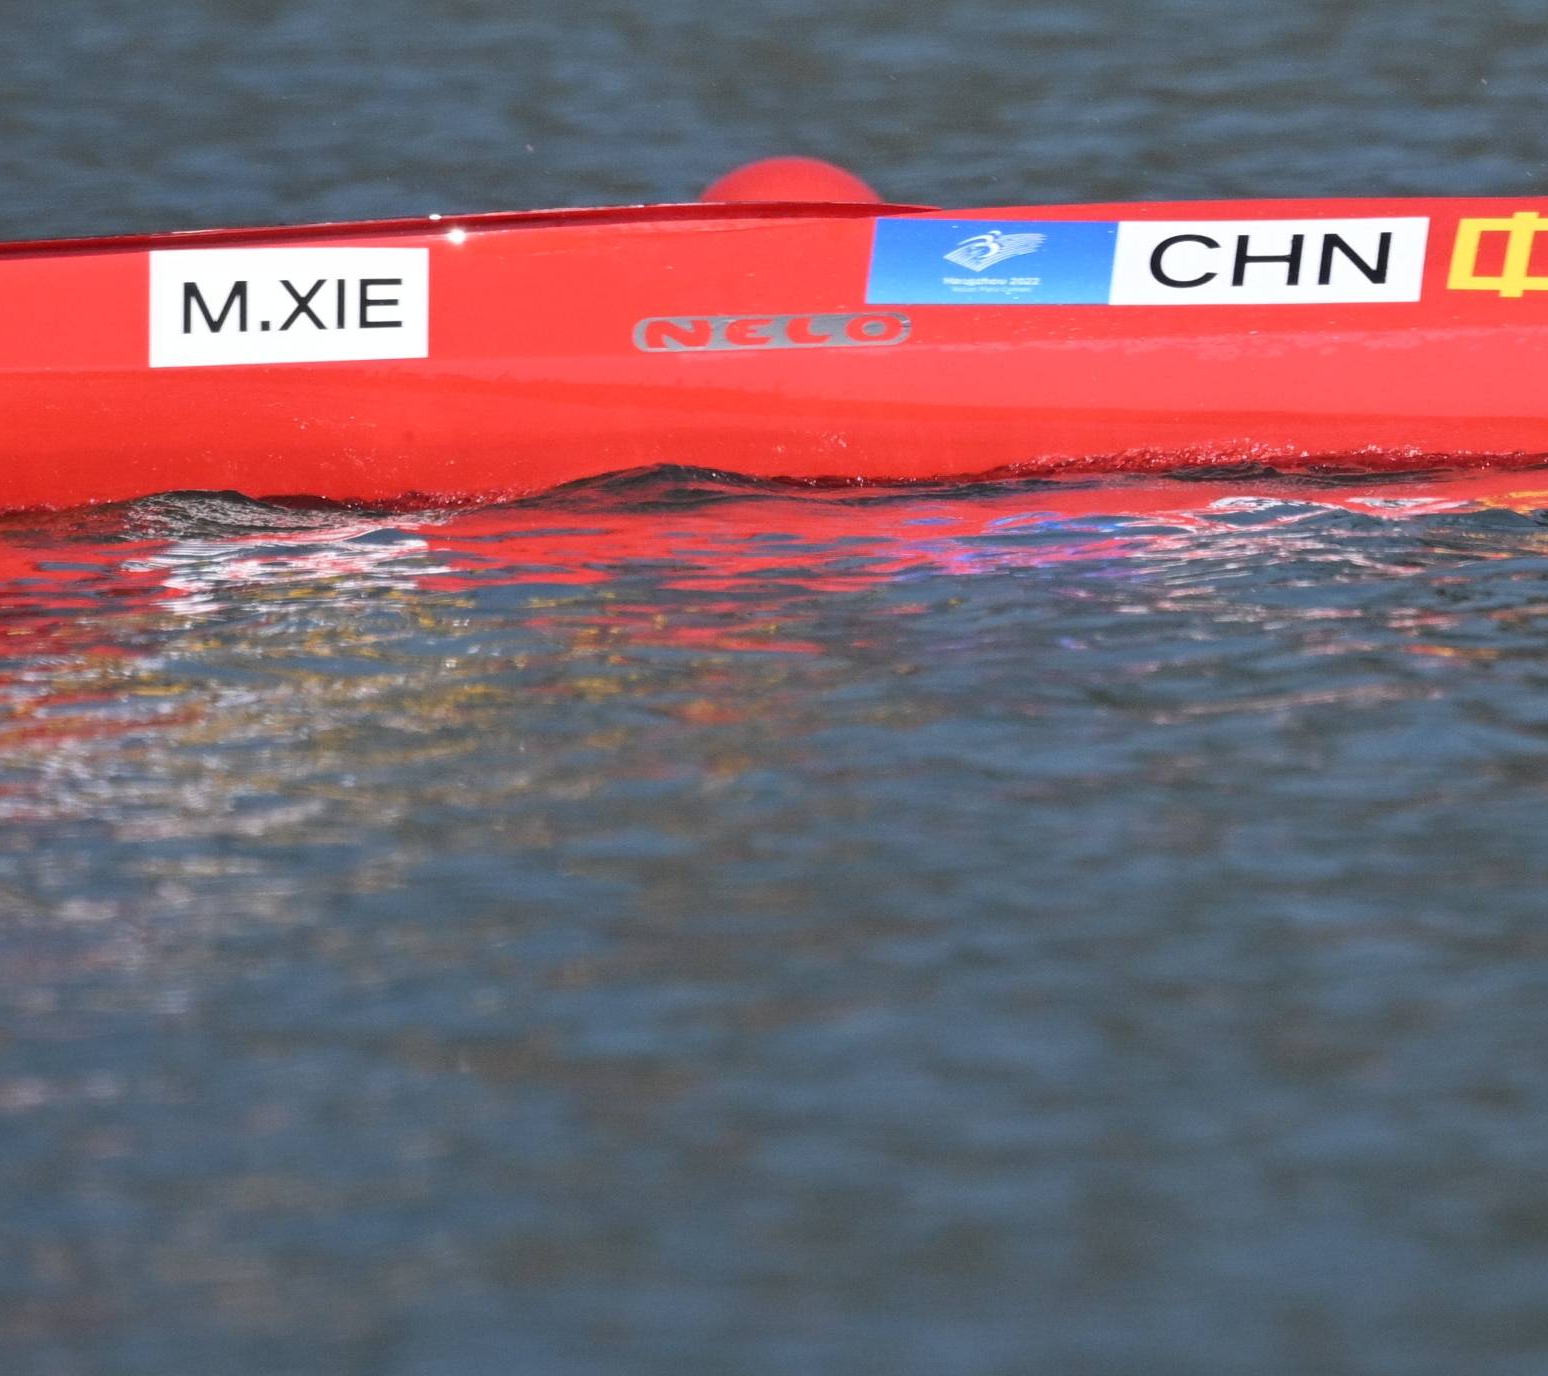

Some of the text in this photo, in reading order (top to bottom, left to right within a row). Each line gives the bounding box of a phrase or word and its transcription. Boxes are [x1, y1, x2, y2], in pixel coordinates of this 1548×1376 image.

[1149, 231, 1393, 288] CHN
[182, 278, 403, 334] M.XIE
[644, 314, 902, 350] NELO
